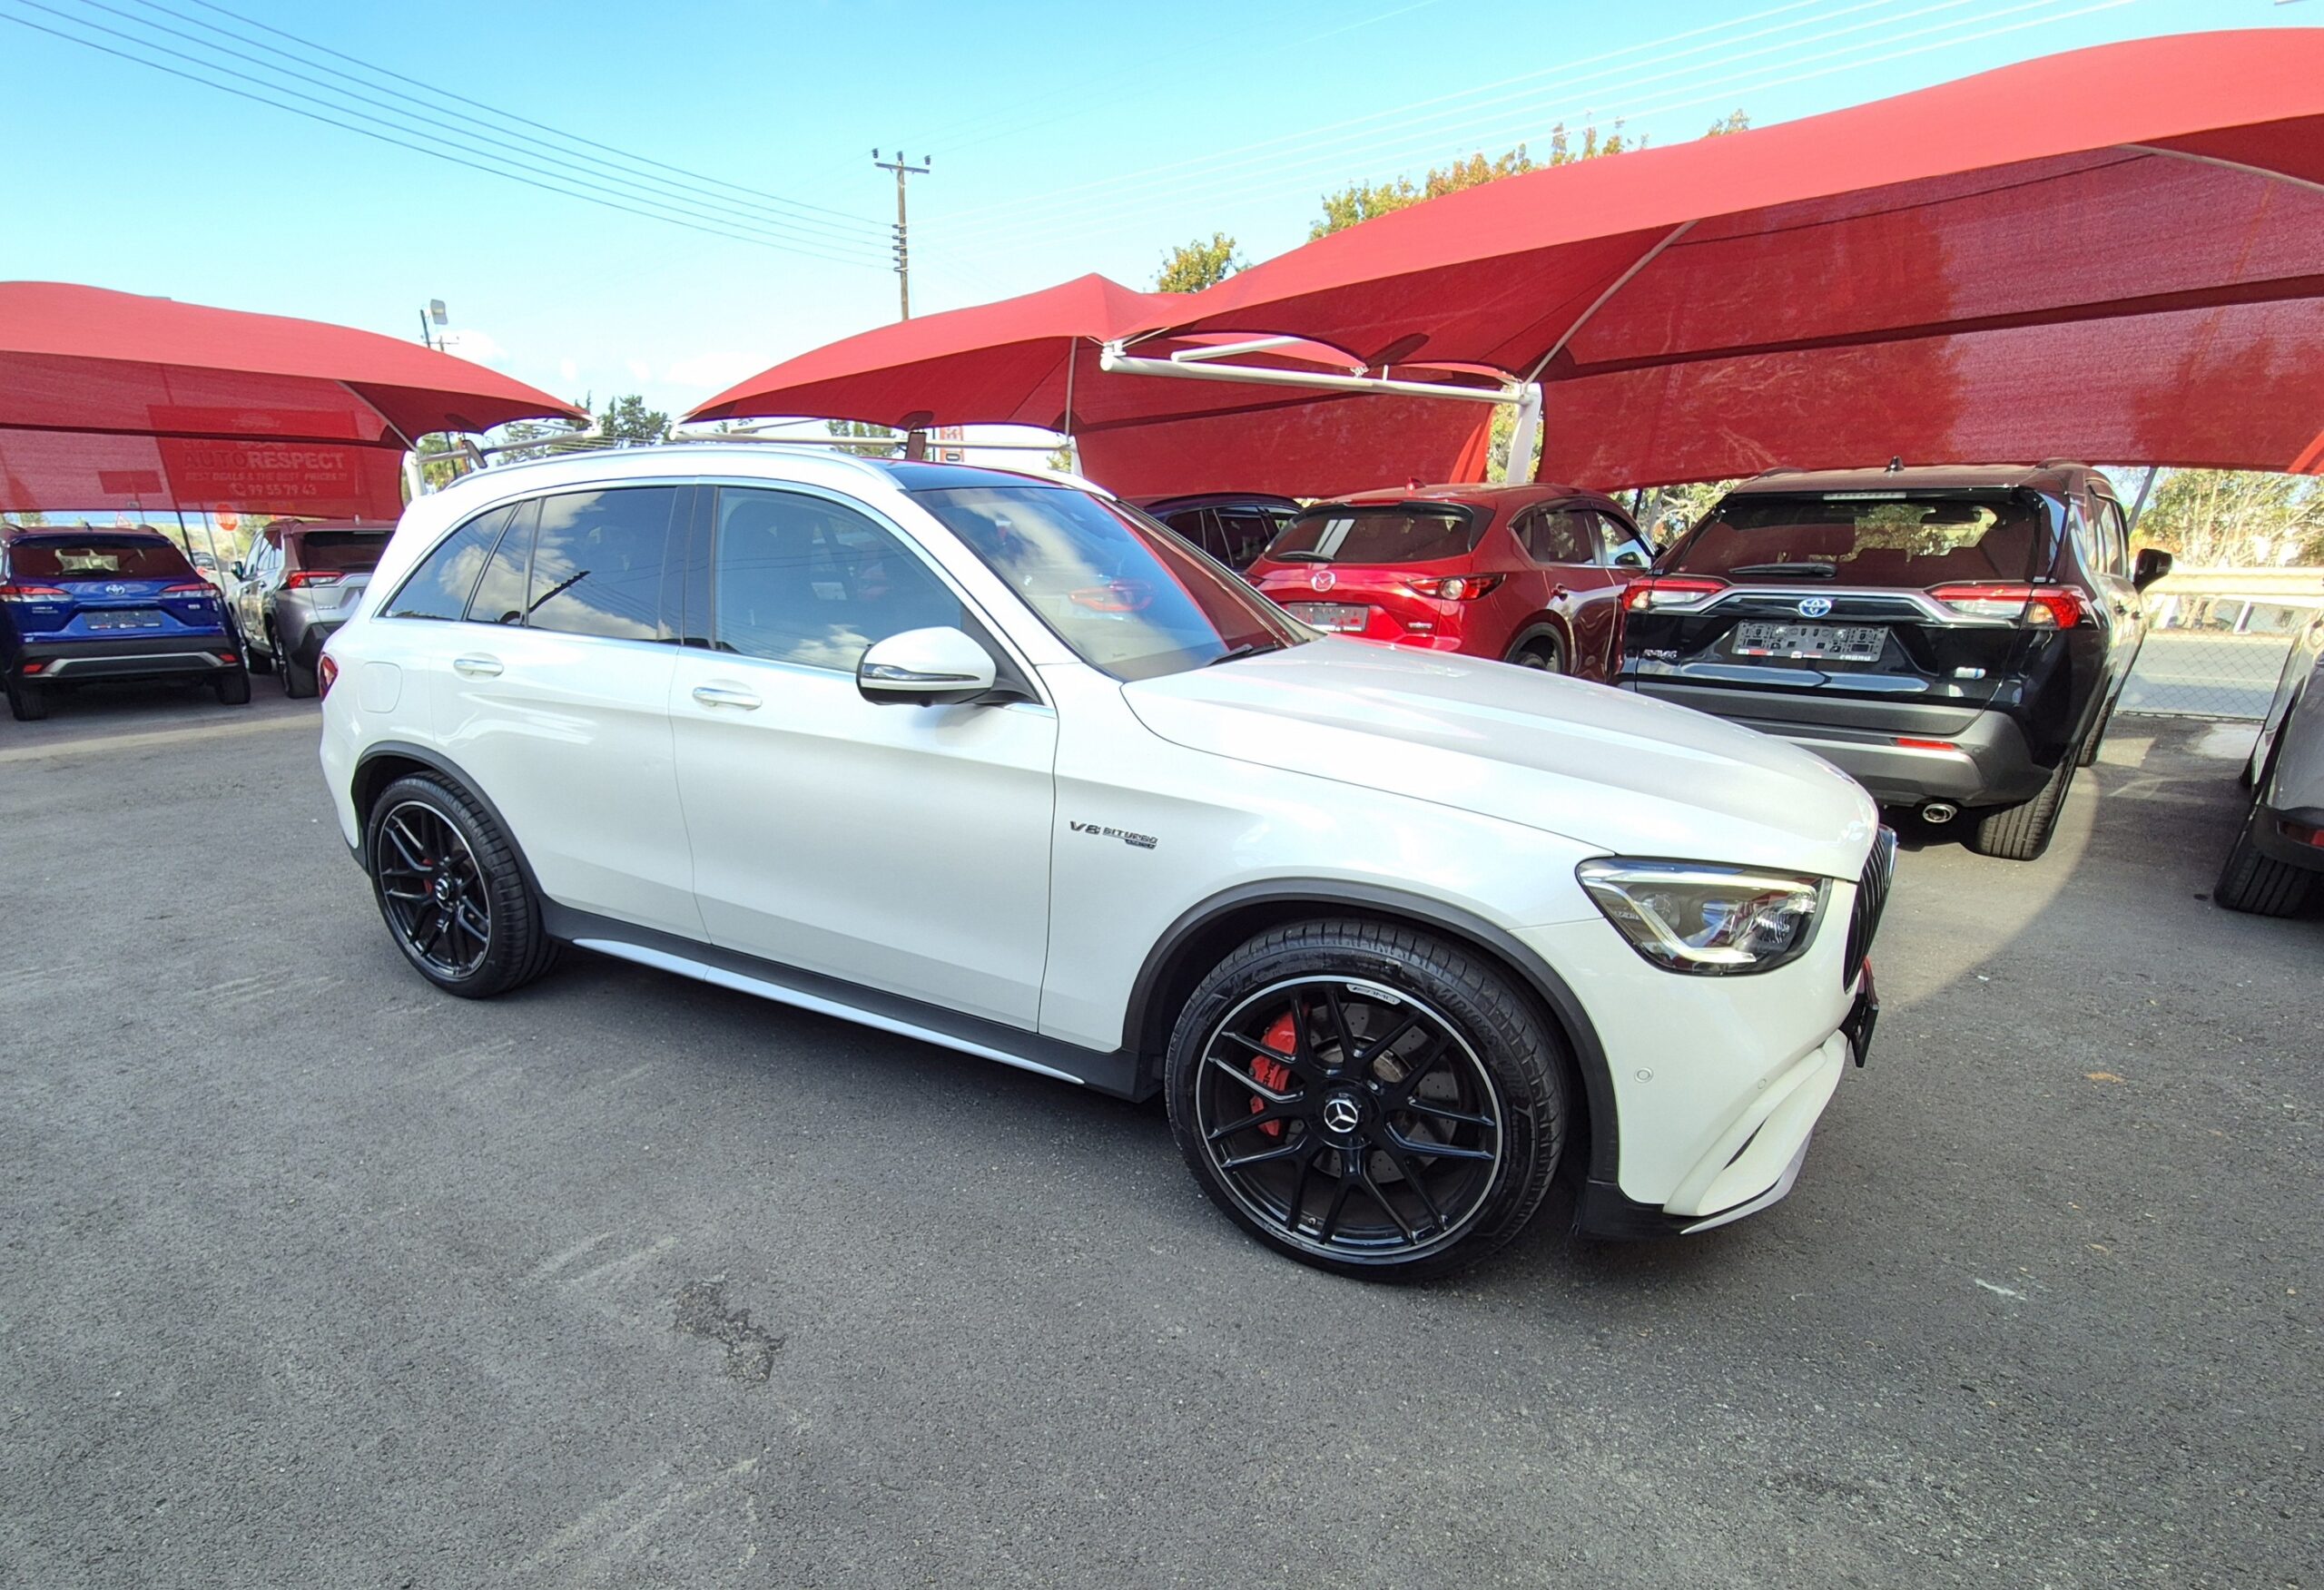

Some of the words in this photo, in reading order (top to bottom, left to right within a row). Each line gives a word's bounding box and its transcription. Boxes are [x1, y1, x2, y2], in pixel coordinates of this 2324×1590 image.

[183, 450, 345, 470] AUTORESPECT
[212, 472, 244, 481] DEALS
[304, 473, 336, 481] PRICES
[248, 485, 263, 495] 99
[267, 485, 281, 495] 55
[283, 486, 299, 495] 79
[1069, 820, 1101, 835] V8
[1102, 827, 1158, 844] BITURBO
